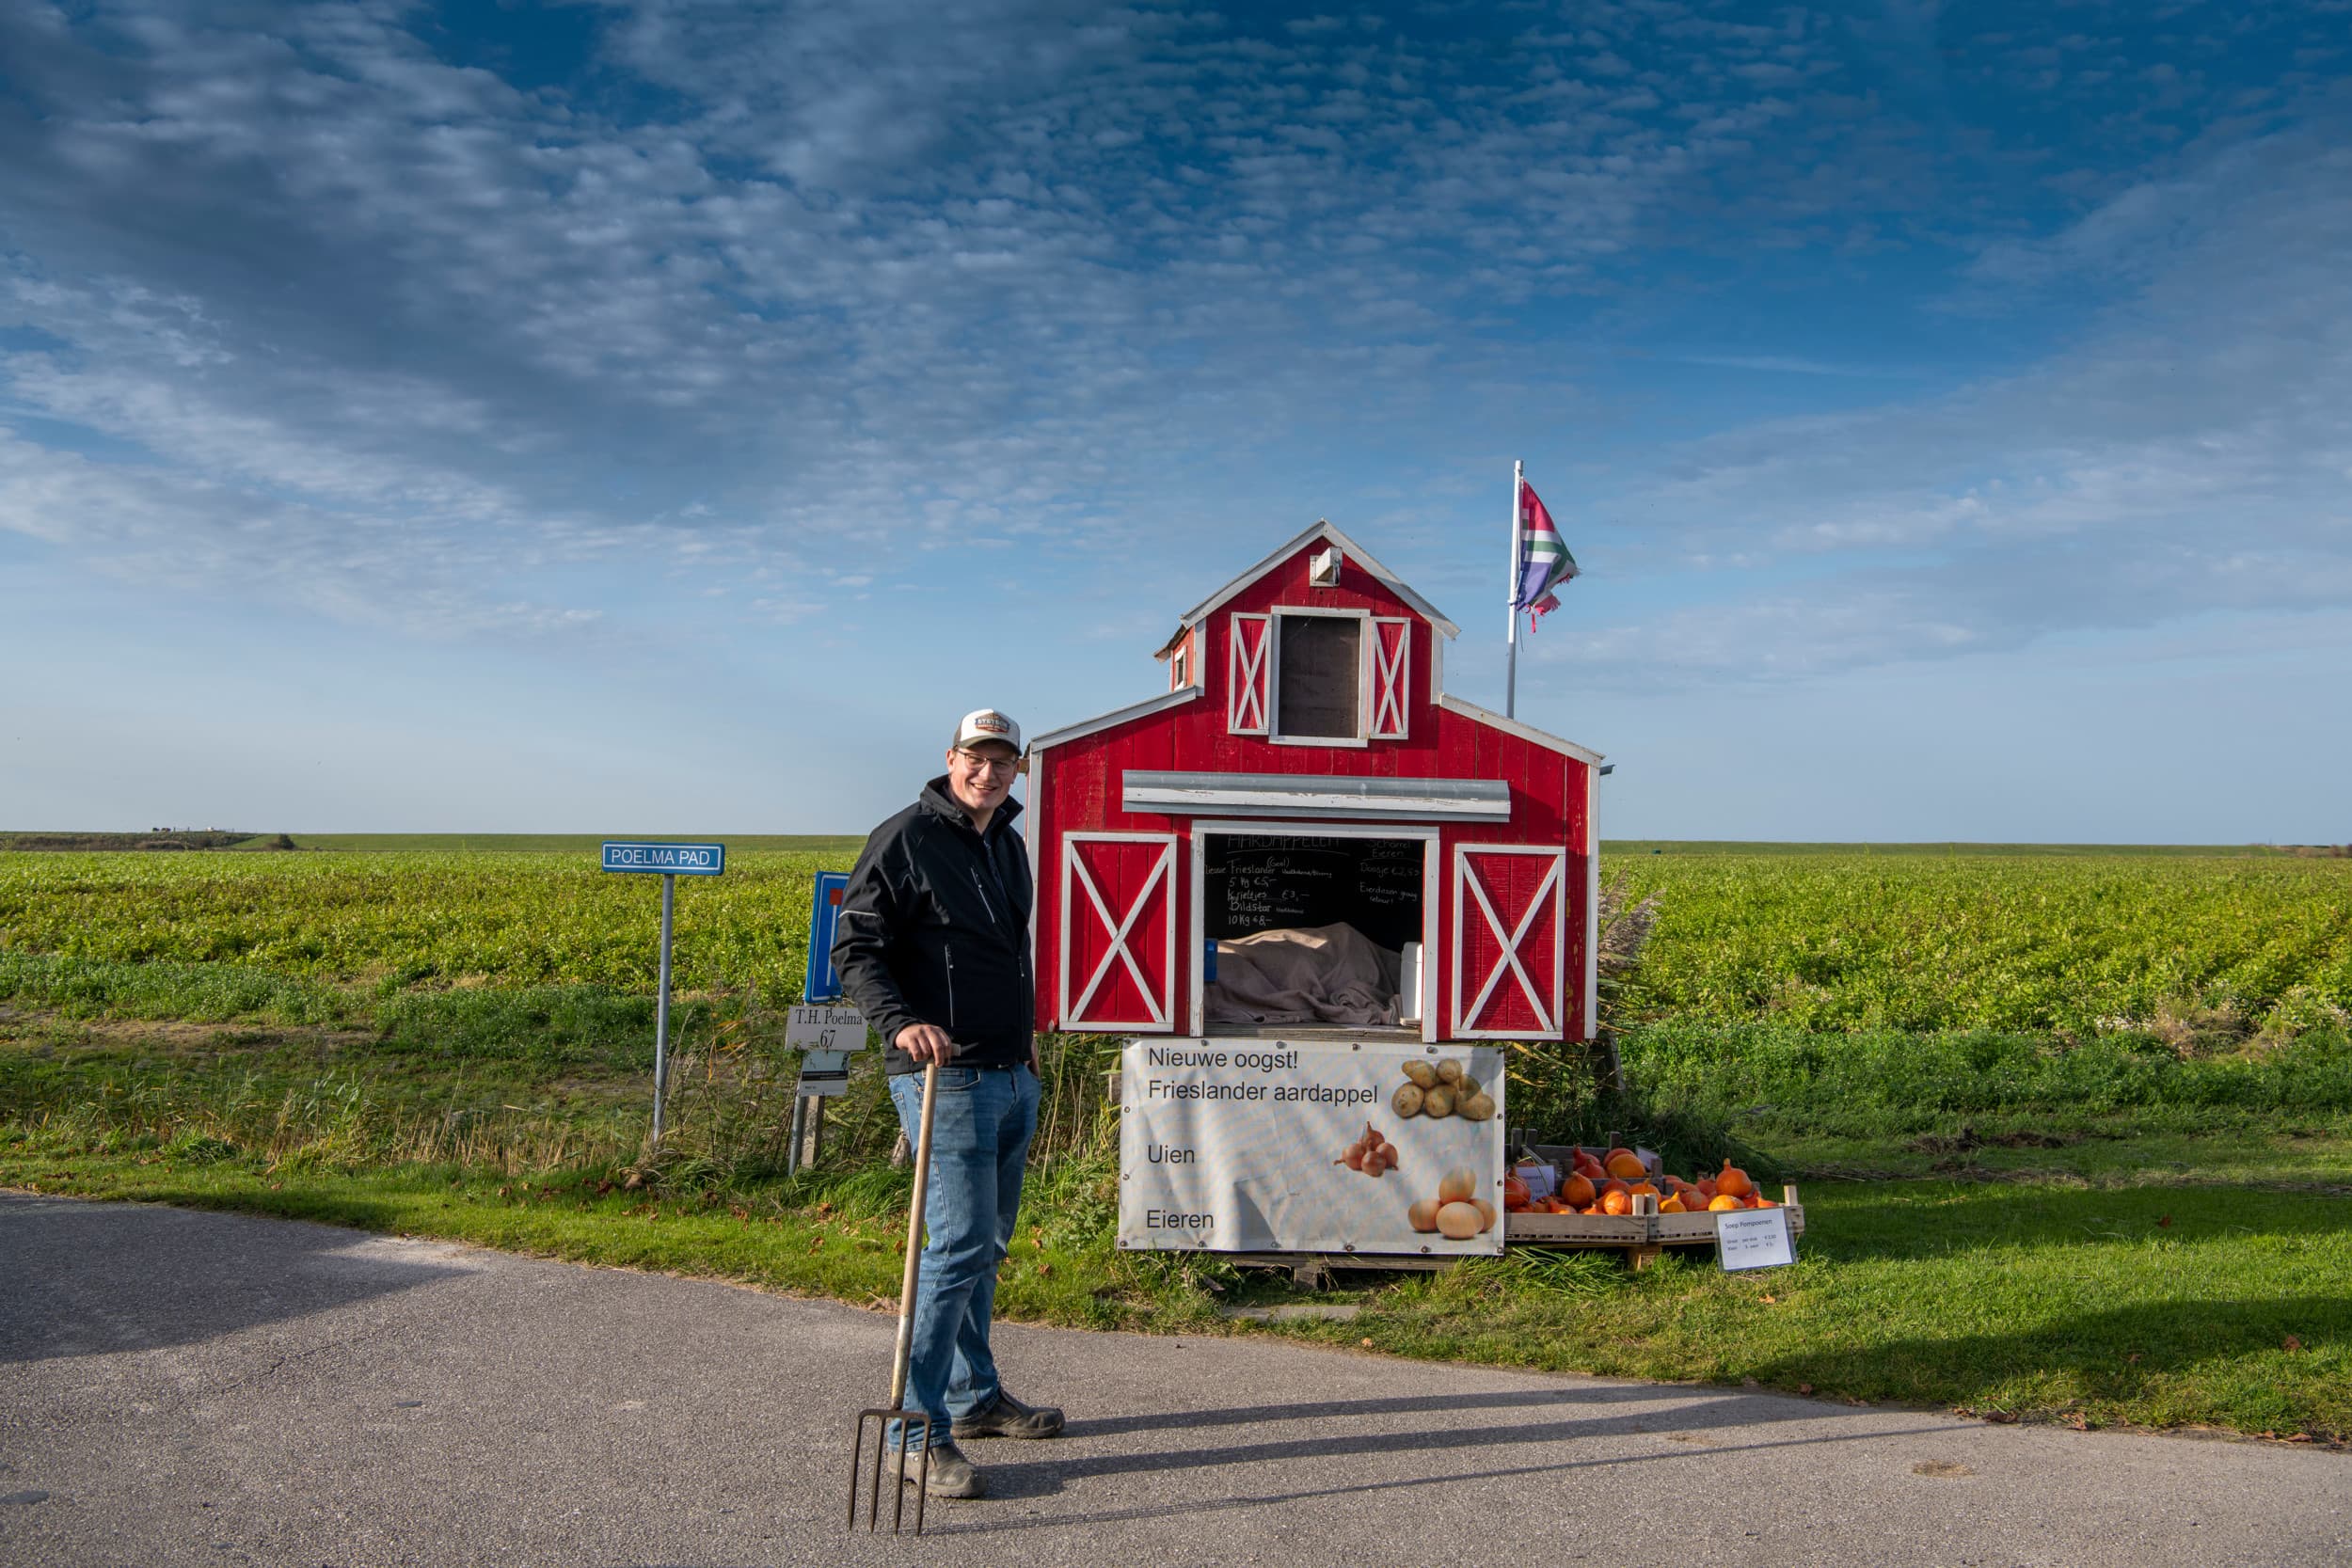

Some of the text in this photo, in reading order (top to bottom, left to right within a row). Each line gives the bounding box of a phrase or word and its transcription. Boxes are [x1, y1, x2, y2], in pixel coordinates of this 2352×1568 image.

[612, 849, 710, 865] POELMA PAD
[796, 1008, 863, 1025] T.H. Poelma
[820, 1029, 836, 1047] 67
[1149, 1048, 1298, 1072] Nieuwe oogst!
[1149, 1080, 1378, 1106] Frieslander aardappel
[1148, 1145, 1195, 1164] Uien
[1147, 1210, 1214, 1228] Eieren
